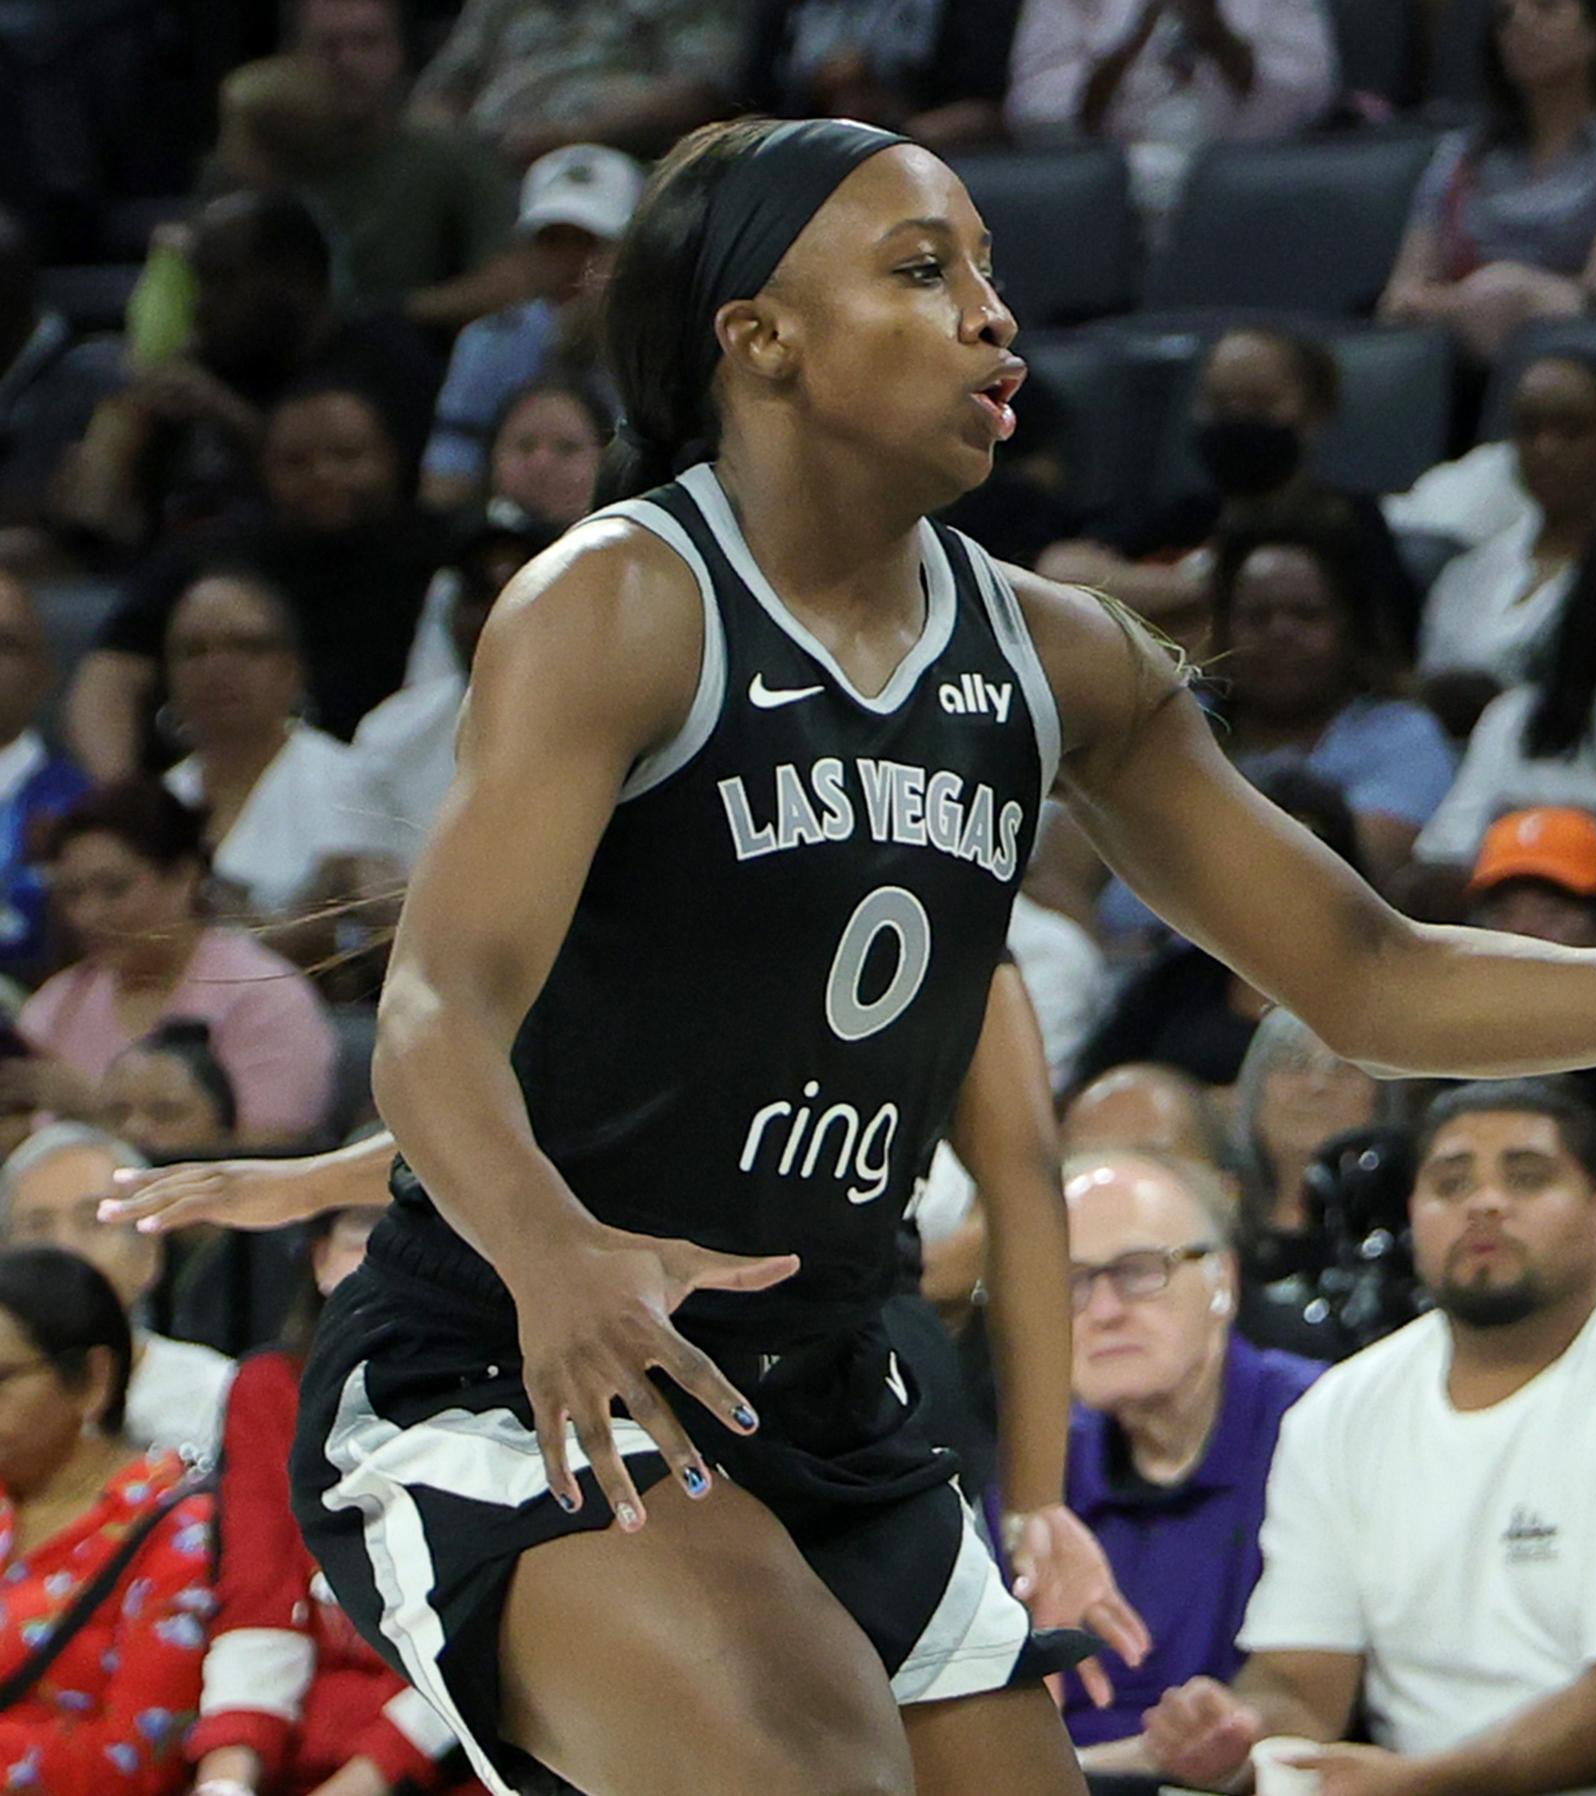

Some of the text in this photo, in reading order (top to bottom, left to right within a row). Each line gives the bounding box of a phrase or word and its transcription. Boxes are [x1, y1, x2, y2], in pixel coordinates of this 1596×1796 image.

[939, 674, 1011, 722] ally
[718, 758, 1022, 880] LAS VEGAS
[826, 886, 930, 1041] 0
[739, 1080, 898, 1204] ring
